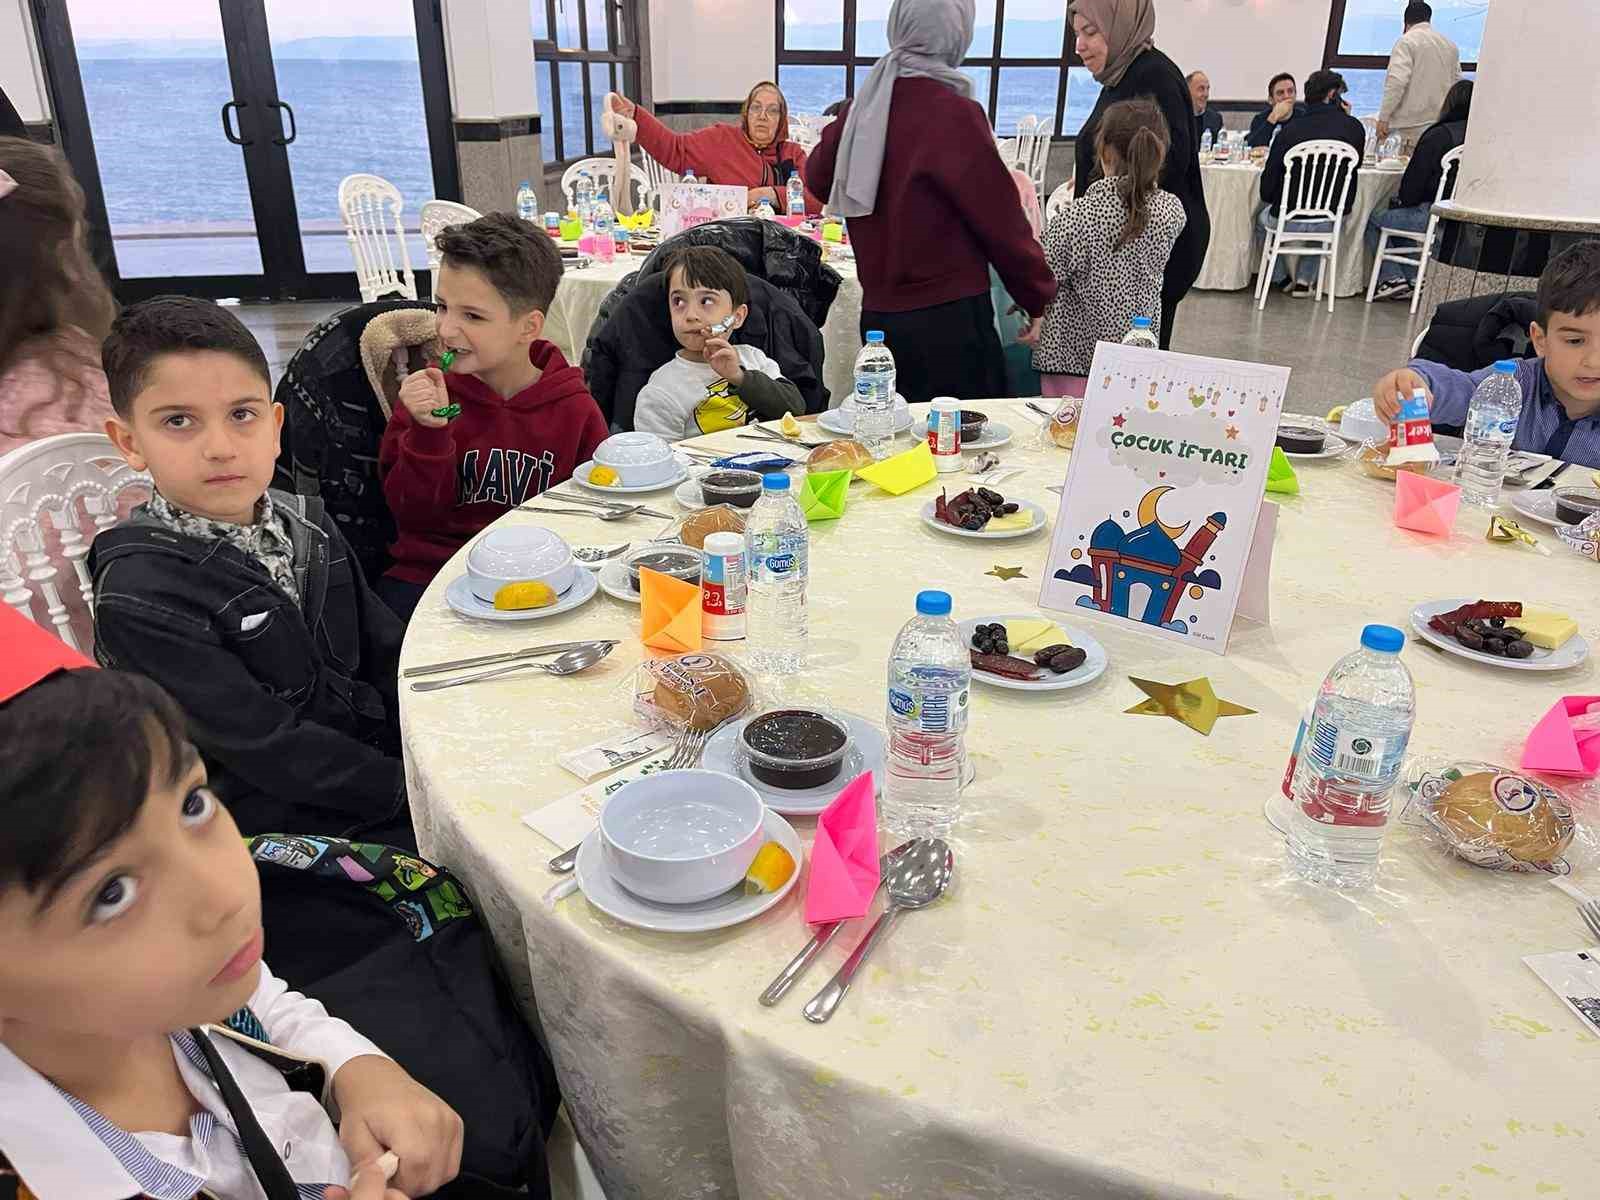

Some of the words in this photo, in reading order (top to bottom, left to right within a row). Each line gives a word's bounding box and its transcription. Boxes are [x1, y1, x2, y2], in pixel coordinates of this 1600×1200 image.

[1407, 424, 1432, 438] ker
[1111, 431, 1174, 455] ÇOCUK
[1177, 439, 1248, 469] İFTARI
